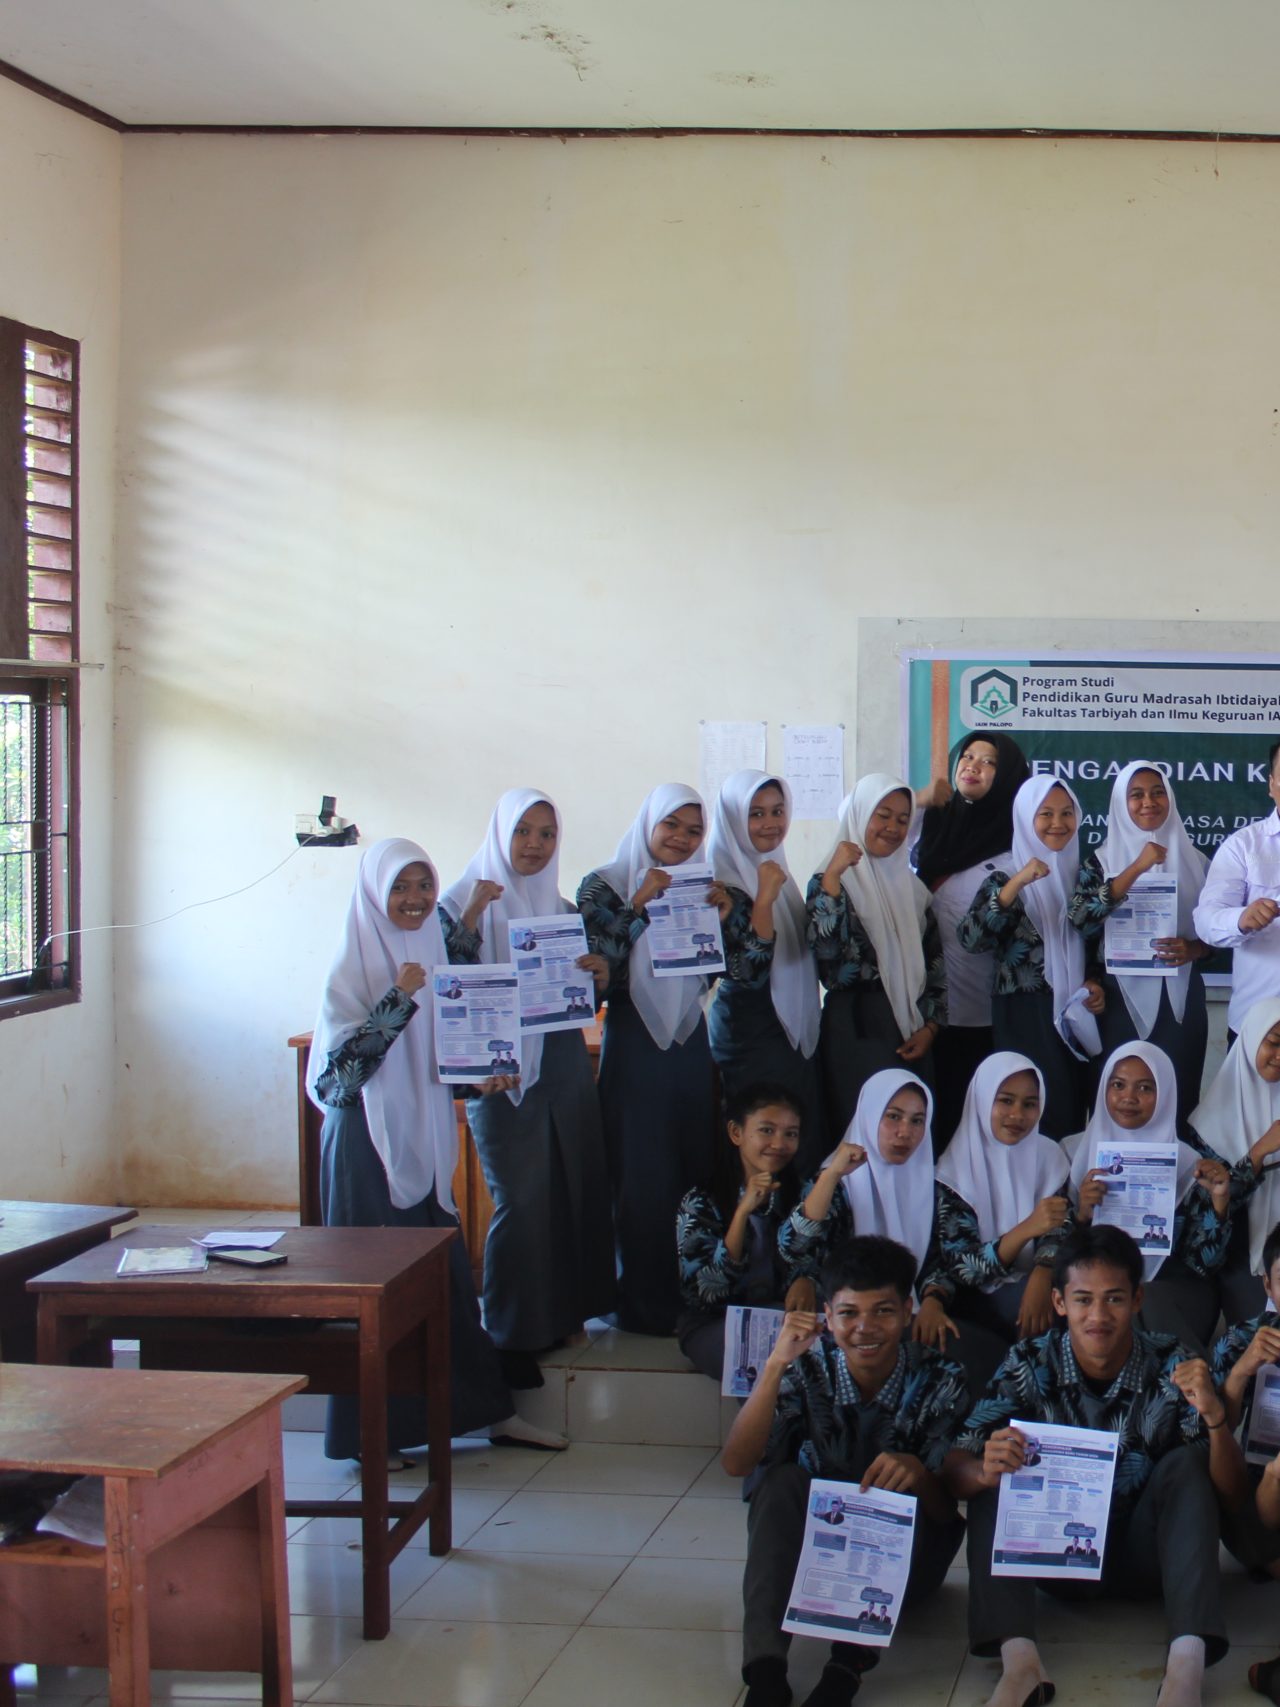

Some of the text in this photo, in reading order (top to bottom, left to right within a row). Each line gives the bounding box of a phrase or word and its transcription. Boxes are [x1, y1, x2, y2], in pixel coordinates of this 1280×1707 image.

[1022, 676, 1115, 689] Program Studi
[1022, 691, 1100, 703] Pendidikan
[1104, 692, 1138, 704] Guru
[1143, 692, 1212, 705] Madrasah
[1022, 707, 1077, 718] Fakultas
[1081, 708, 1137, 721] Tarbiyah
[1141, 708, 1165, 719] dan
[1169, 709, 1198, 720] Ilmu
[1202, 710, 1264, 723] Keguruan
[1027, 760, 1234, 783] ENGADIAN
[1183, 815, 1225, 829] ASA
